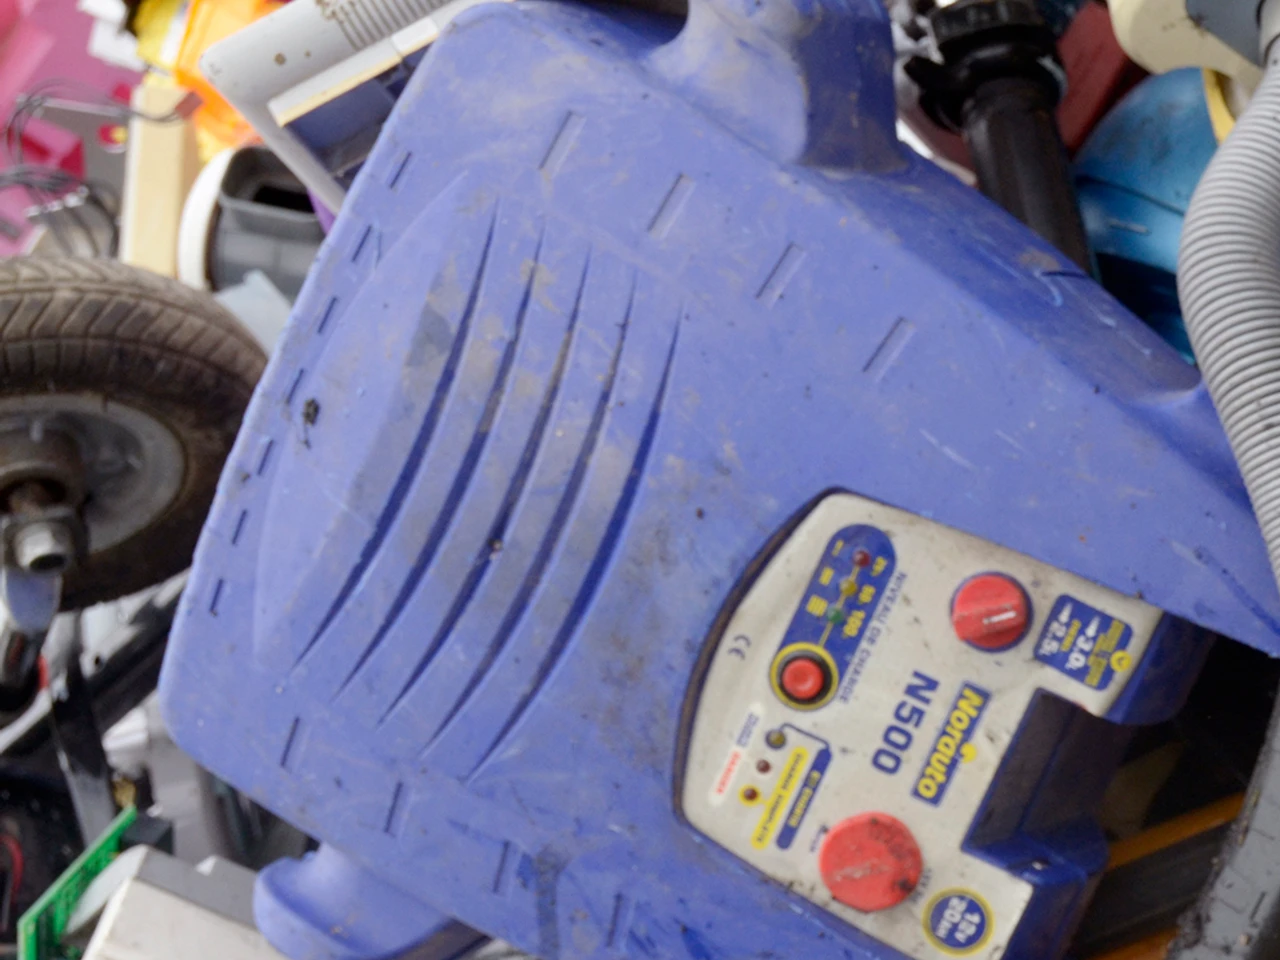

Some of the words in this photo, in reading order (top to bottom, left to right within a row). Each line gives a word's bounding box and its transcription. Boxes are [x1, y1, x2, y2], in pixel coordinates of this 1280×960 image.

[874, 570, 908, 625] NIVEAU
[837, 648, 871, 704] CHARGE
[867, 668, 940, 779] N500
[912, 685, 986, 803] Norauto
[952, 908, 983, 946] 12V
